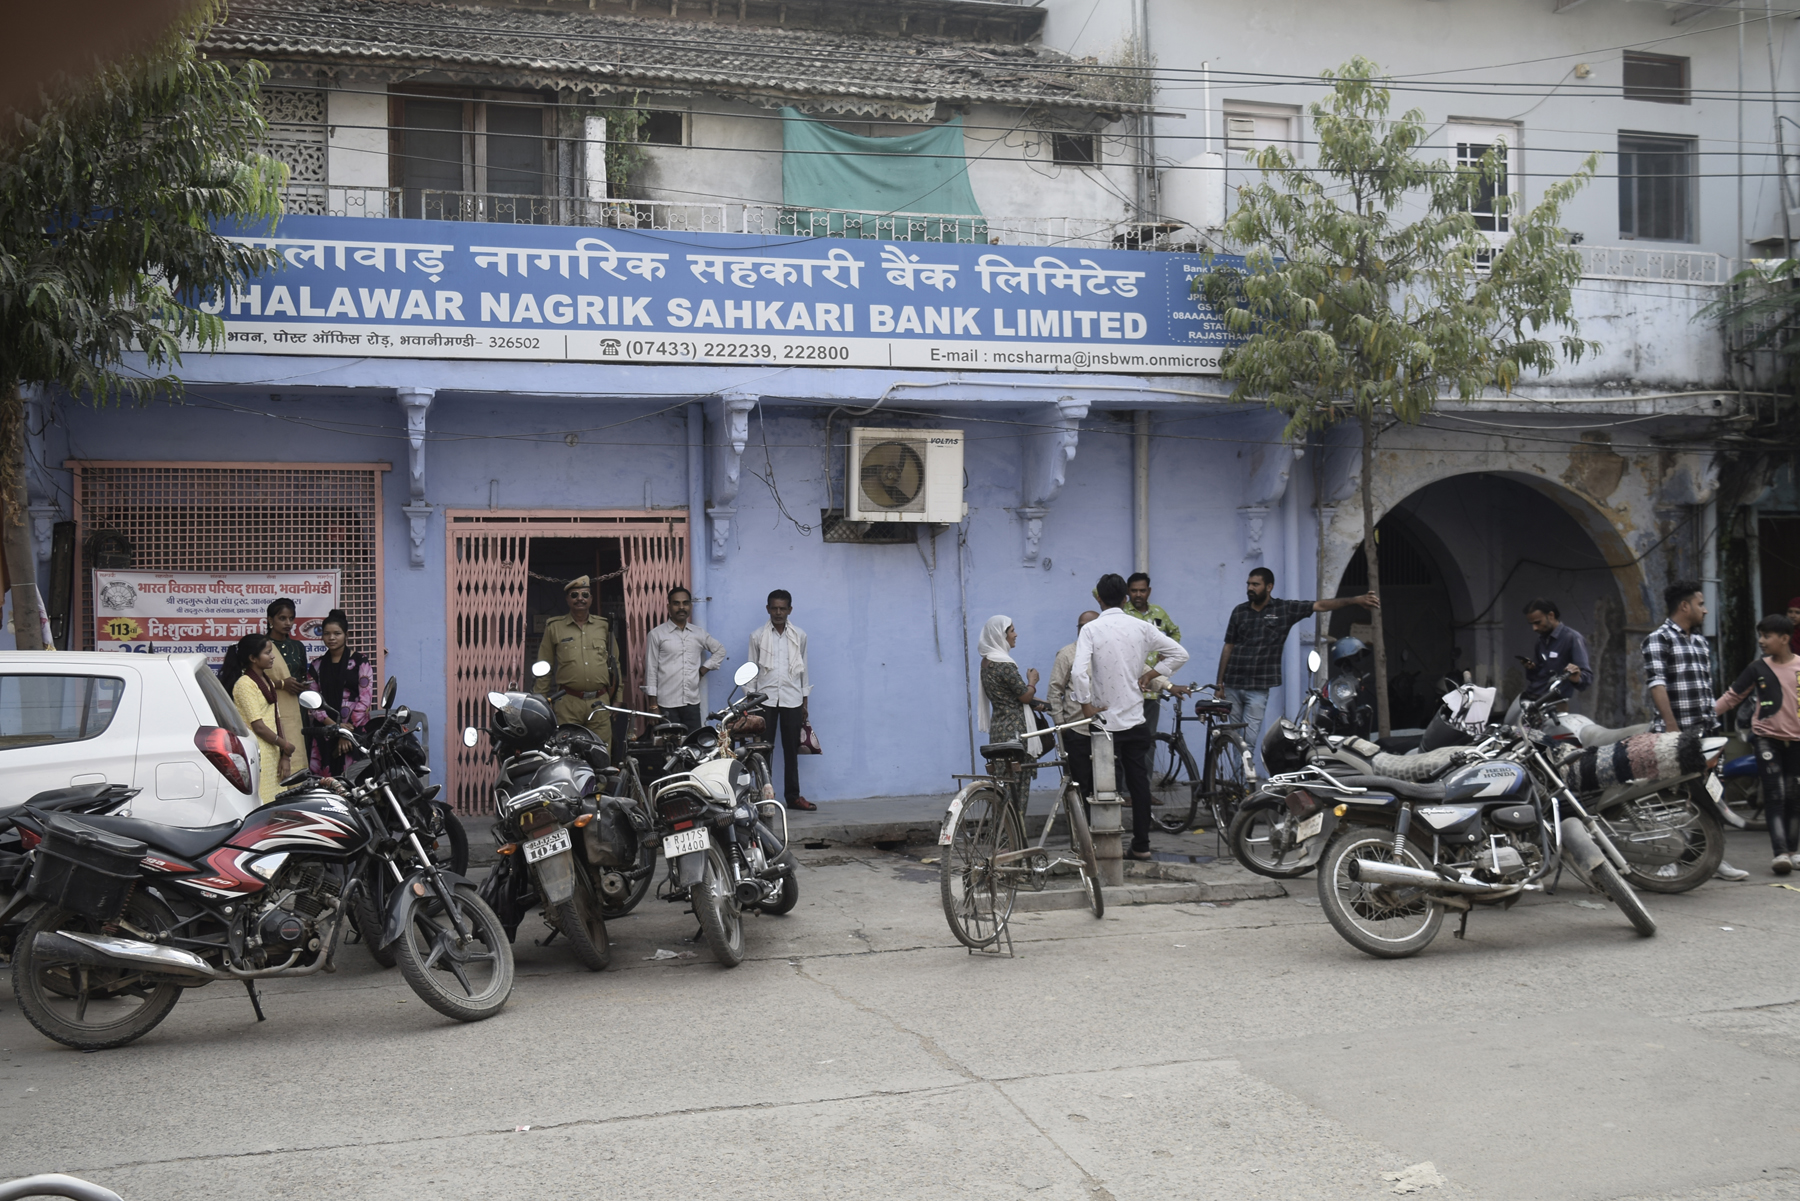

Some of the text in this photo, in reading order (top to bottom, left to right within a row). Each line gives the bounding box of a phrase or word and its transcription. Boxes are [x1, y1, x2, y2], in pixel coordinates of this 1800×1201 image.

[470, 238, 669, 281] नागरिक
[686, 248, 864, 289] सहकारी
[881, 245, 959, 292] बैंक
[975, 254, 1145, 297] लिमिटेड
[1183, 264, 1208, 273] Bank
[199, 284, 1147, 339] JHALAWAR NAGRIK SAHKARI BANK LIMITED
[1203, 322, 1229, 331] STAT
[228, 331, 267, 344] भवन,
[273, 329, 307, 343] पोस्ट
[313, 330, 362, 345] ऑफिस
[489, 336, 540, 349] 326502
[626, 340, 849, 360] (07433) 222239, 222800
[931, 348, 978, 363] E-mail
[138, 583, 167, 593] भारत
[168, 579, 207, 594] विकास
[209, 580, 244, 596] परिषद्
[246, 583, 277, 595] शाखा,
[279, 580, 332, 594] भवानीमंडी
[166, 596, 175, 605] श्री
[205, 596, 218, 605] सेवा
[320, 806, 349, 816] HONDA
[674, 829, 703, 845] RJ17S
[676, 840, 705, 854] Y4400
